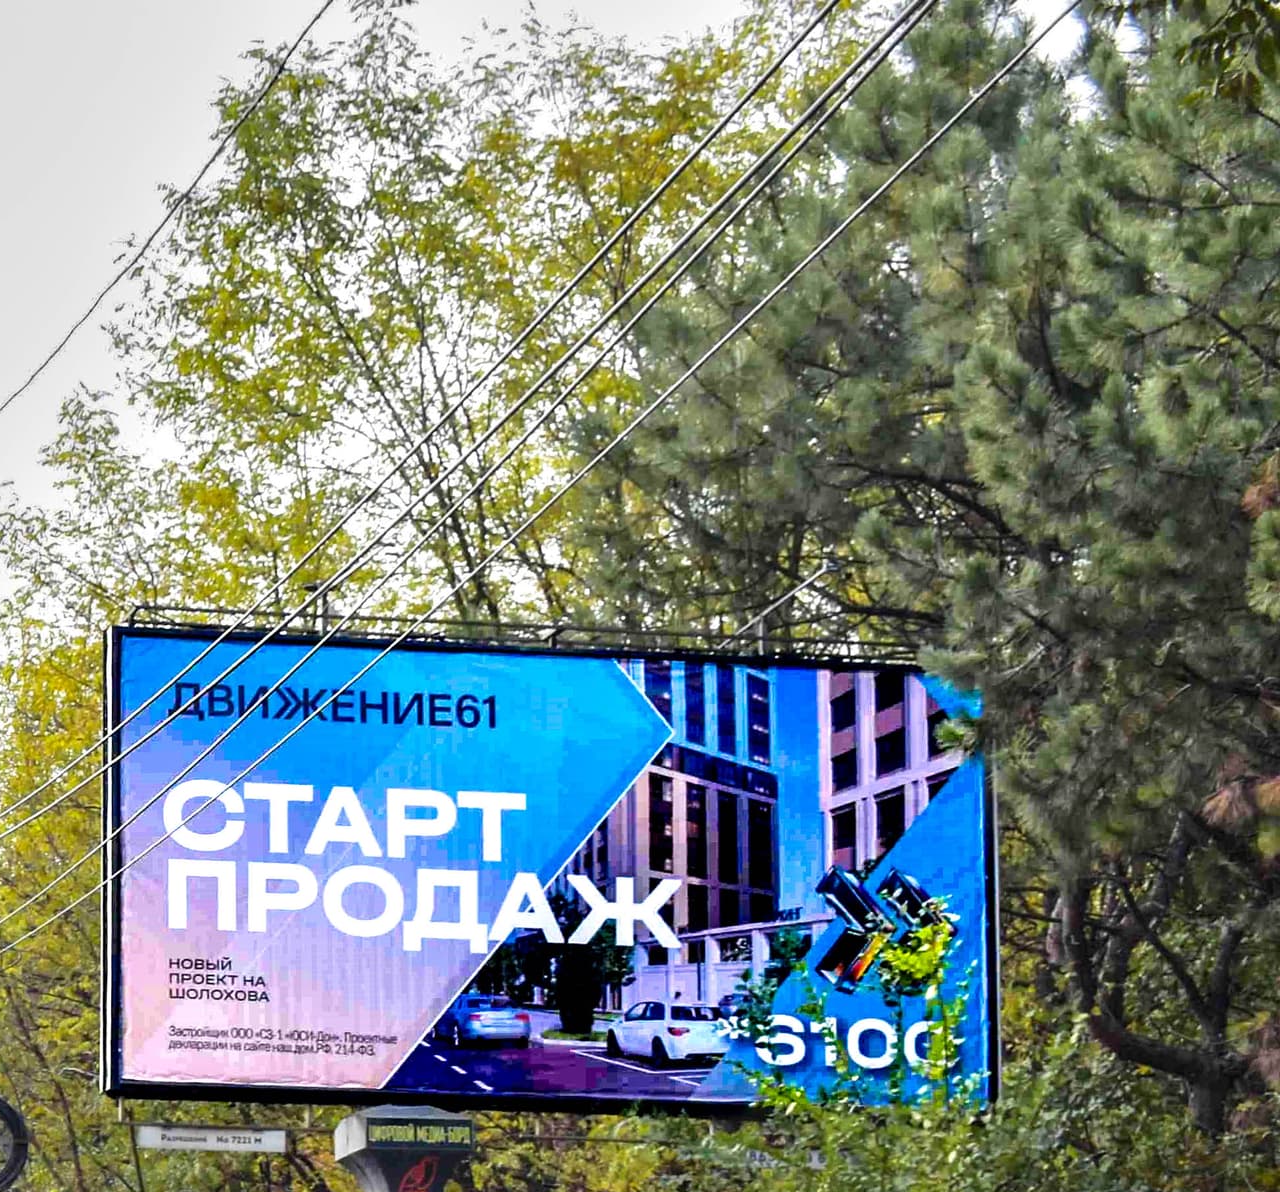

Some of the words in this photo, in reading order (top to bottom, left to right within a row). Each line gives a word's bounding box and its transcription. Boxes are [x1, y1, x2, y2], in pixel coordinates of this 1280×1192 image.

[167, 682, 497, 729] ДВИЖЕНИЕ61
[163, 778, 527, 863] СТАРТ
[167, 858, 682, 954] ПРОДАЖ
[168, 956, 233, 971] НОВЫЙ
[168, 972, 238, 986] ПРОЕКТ
[243, 975, 267, 988] НА
[168, 987, 271, 1002] ШОЛОХОВА
[168, 1025, 230, 1040] Застройщик
[231, 1027, 254, 1040] ООО
[168, 1040, 228, 1052] декларации
[243, 1041, 271, 1053] сайте
